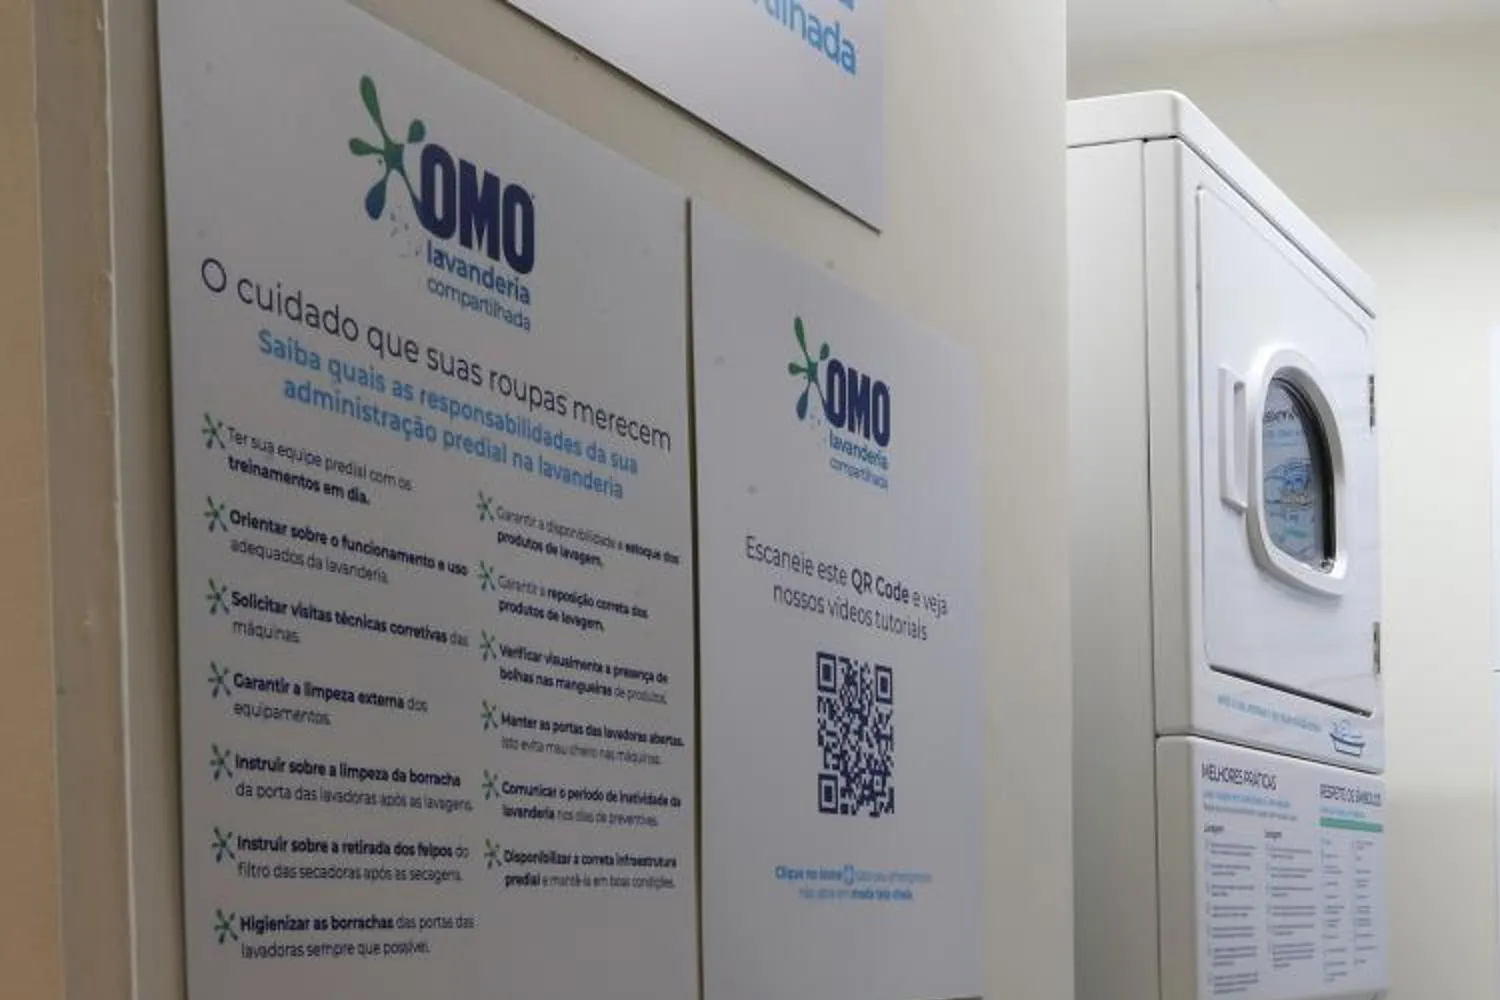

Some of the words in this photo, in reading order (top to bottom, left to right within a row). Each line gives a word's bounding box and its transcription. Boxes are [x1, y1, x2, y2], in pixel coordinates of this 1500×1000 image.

[420, 143, 535, 274] OMO
[427, 239, 530, 305] lavanderia
[427, 277, 531, 332] compartilhada
[201, 258, 227, 293] O
[237, 278, 359, 342] cuidado
[367, 326, 419, 363] que
[426, 347, 483, 387] suas
[489, 369, 568, 416] roupas
[572, 399, 672, 453] merecem
[258, 328, 321, 371] Saiba
[328, 357, 386, 393] quais
[392, 379, 414, 401] as
[420, 388, 583, 456] responsabilidades
[586, 441, 607, 465] da
[611, 452, 638, 475] sua
[825, 358, 890, 447] OMO
[284, 378, 437, 442] administração
[443, 429, 507, 465] predial
[513, 451, 534, 472] na
[539, 454, 623, 500] lavanderia
[829, 429, 888, 471] lavanderia
[227, 425, 248, 447] Ter
[251, 437, 275, 454] sua
[277, 443, 322, 468] equipe
[370, 469, 397, 487] com
[228, 456, 320, 494] treinamentos
[323, 481, 344, 499] em
[229, 509, 287, 537] Orientar
[291, 525, 327, 546] sobre
[330, 535, 339, 548] o
[342, 534, 436, 571] funcionamento
[447, 561, 468, 577] uso
[545, 541, 558, 556] de
[745, 535, 814, 577] Escaneie
[817, 562, 848, 586] este
[851, 568, 873, 595] QR
[875, 576, 909, 604] Code
[912, 591, 921, 607] e
[922, 592, 948, 619] veja
[231, 590, 288, 615] Solicitar
[291, 602, 333, 624] visitas
[546, 607, 559, 622] de
[773, 583, 825, 615] nossos
[875, 609, 928, 641] tutoriais
[233, 672, 290, 693] Garantir
[293, 683, 300, 695] a
[303, 681, 355, 703] limpeza
[536, 675, 554, 688] nas
[501, 712, 537, 730] Manter
[235, 754, 285, 773] Instruir
[289, 759, 326, 777] sobre
[329, 765, 337, 777] a
[339, 762, 389, 783] limpeza
[391, 768, 407, 783] da
[236, 783, 253, 798] da
[256, 785, 291, 801] porta
[295, 785, 317, 802] das
[501, 781, 557, 798] Comunicar
[502, 804, 555, 820] lavanderia
[237, 835, 288, 851] Instruir
[291, 836, 328, 854] sobre
[331, 843, 339, 854] a
[273, 863, 297, 879] das
[299, 862, 361, 880] secadoras
[505, 872, 540, 888] predial
[239, 914, 310, 935] Higienizar
[314, 916, 328, 931] as
[331, 914, 394, 930] borrachas
[240, 941, 304, 959] lavadoras
